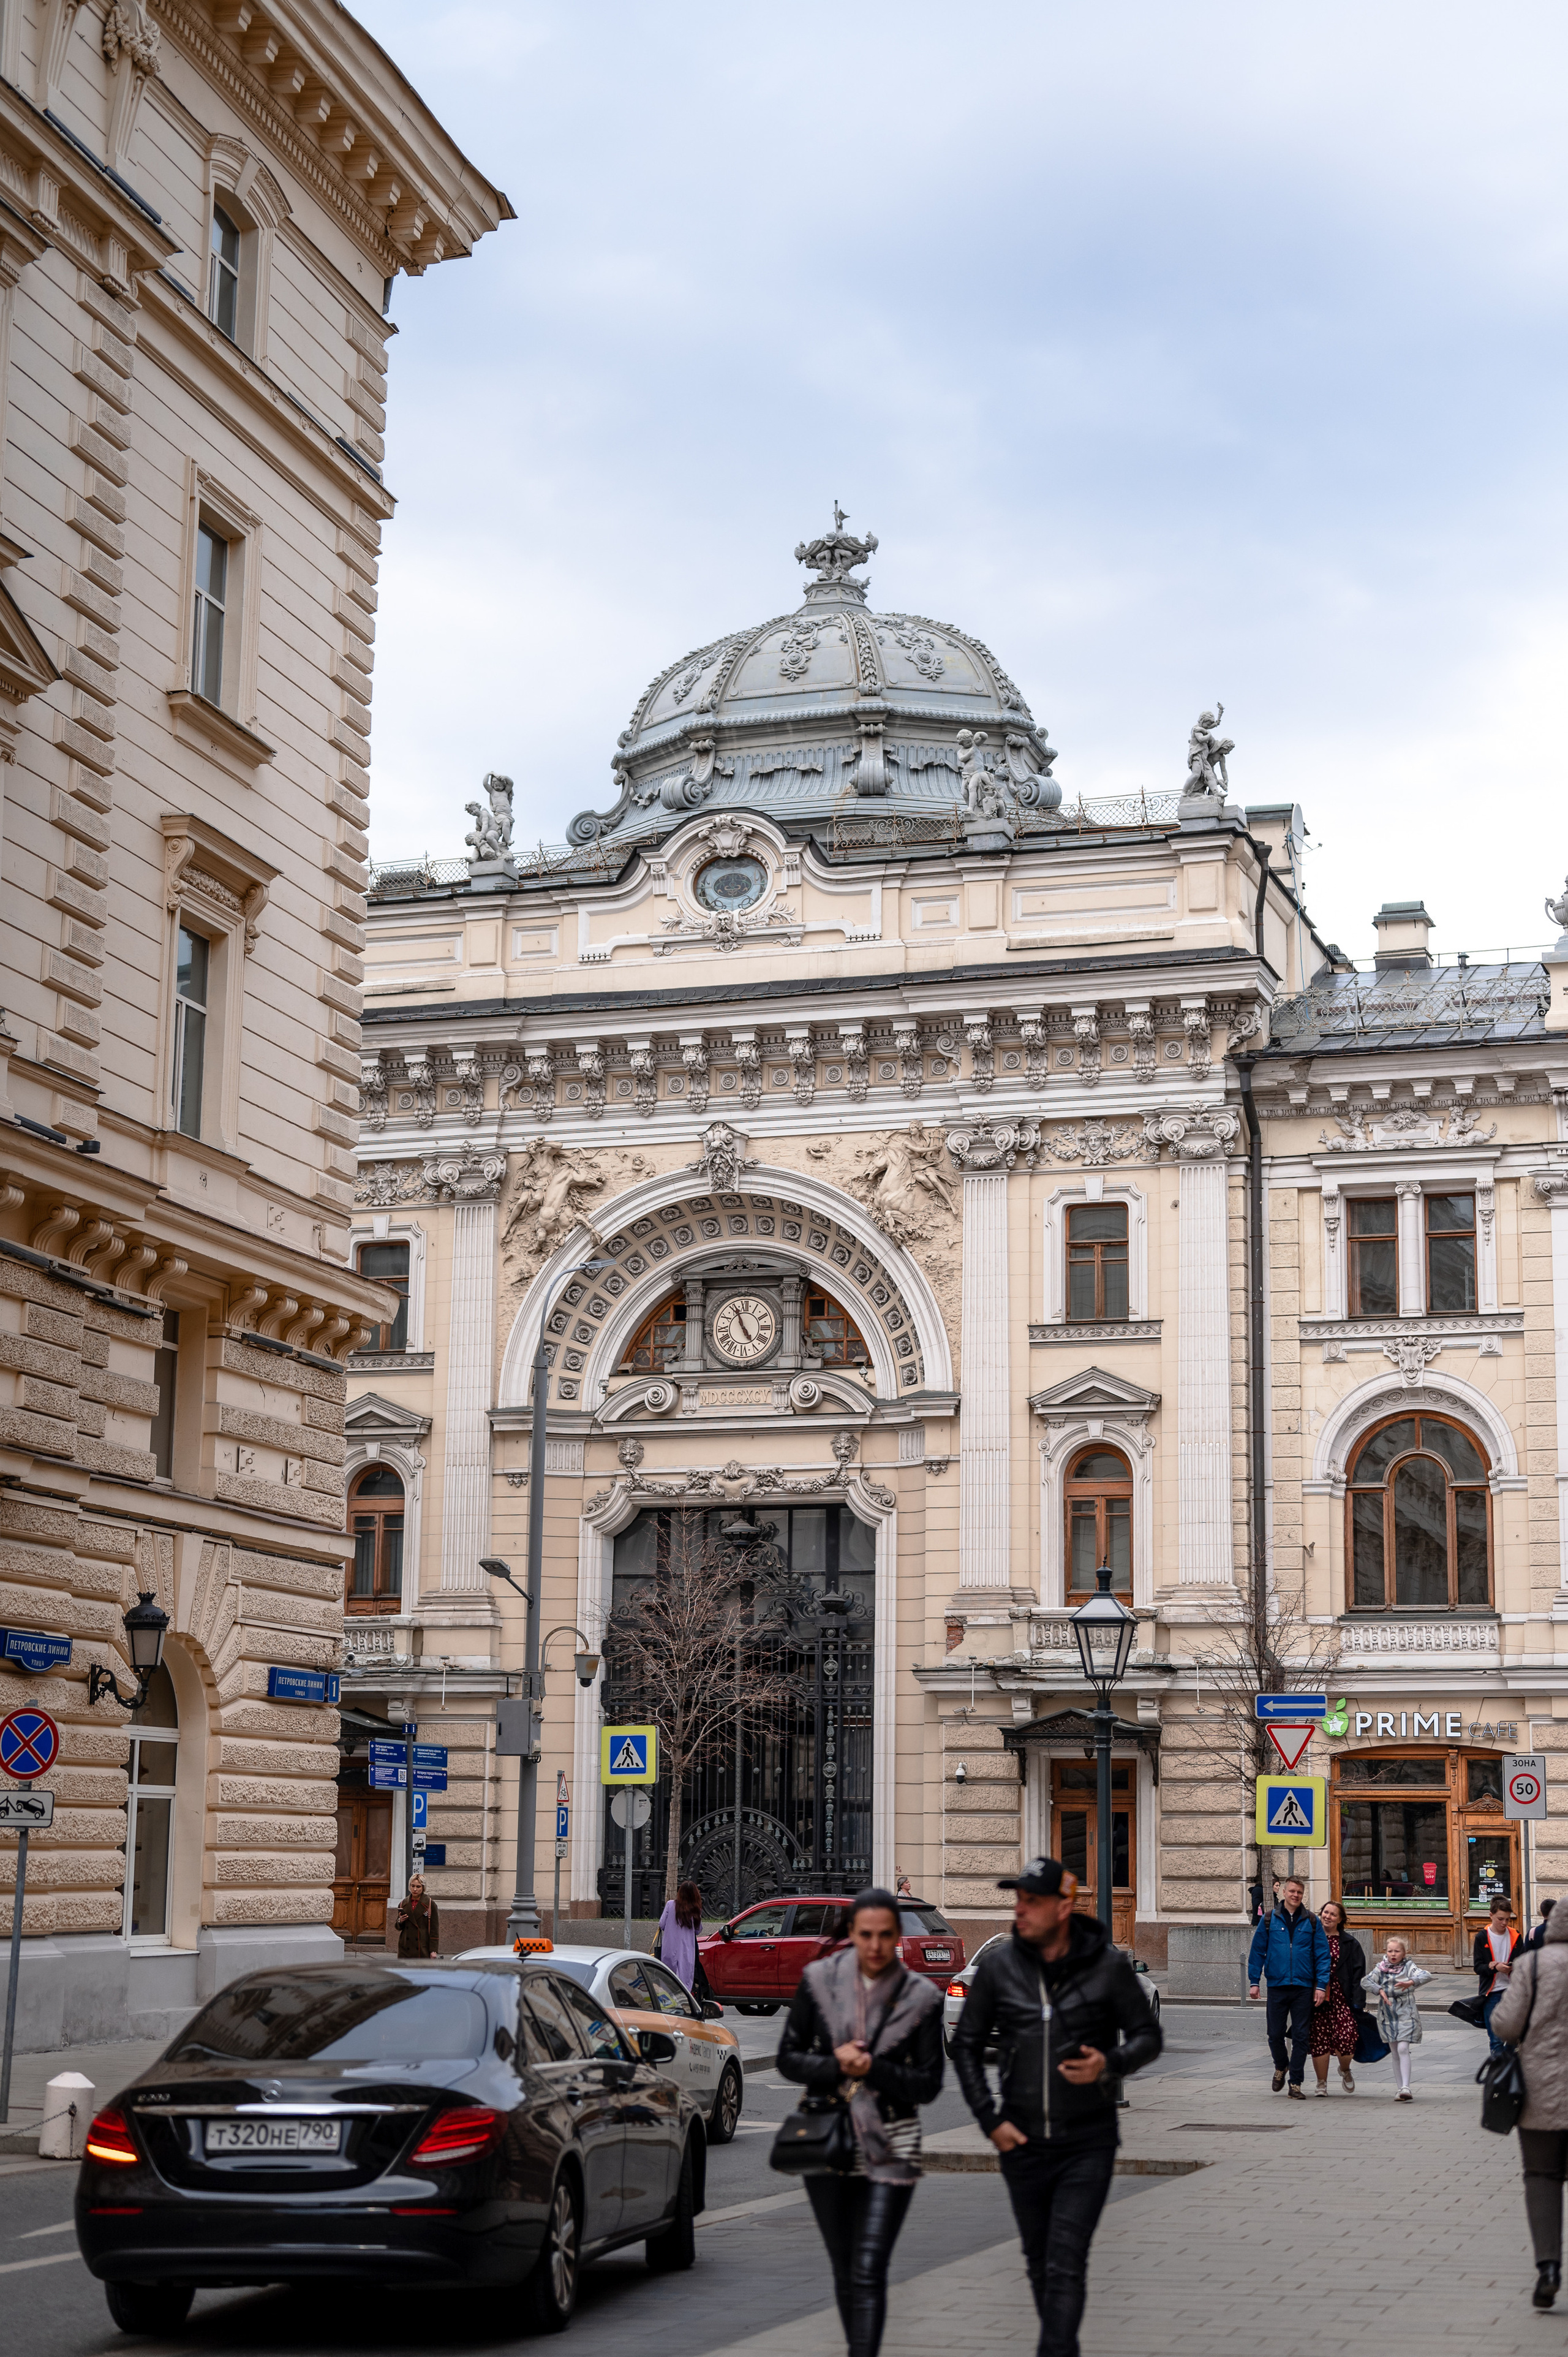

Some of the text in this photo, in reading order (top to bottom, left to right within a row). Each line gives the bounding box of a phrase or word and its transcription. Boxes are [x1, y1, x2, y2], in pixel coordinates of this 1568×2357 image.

[740, 1301, 749, 1312] XII
[700, 1389, 771, 1405] MDCCCXCV
[10, 1640, 69, 1656] ПЕТРОВСКИЕ ЛИНИИ
[31, 1659, 45, 1667] УЛИЦА
[278, 1676, 323, 1689] ПЕТРОВСКИЕ ЛИНИИ
[332, 1681, 336, 1697] 1
[1355, 1711, 1518, 1738] PRIME CAFE
[1517, 1783, 1533, 1795] 50
[559, 1810, 567, 1834] P
[689, 2038, 701, 2057] Яндекс
[216, 2122, 333, 2146] Т320НЕ 790
